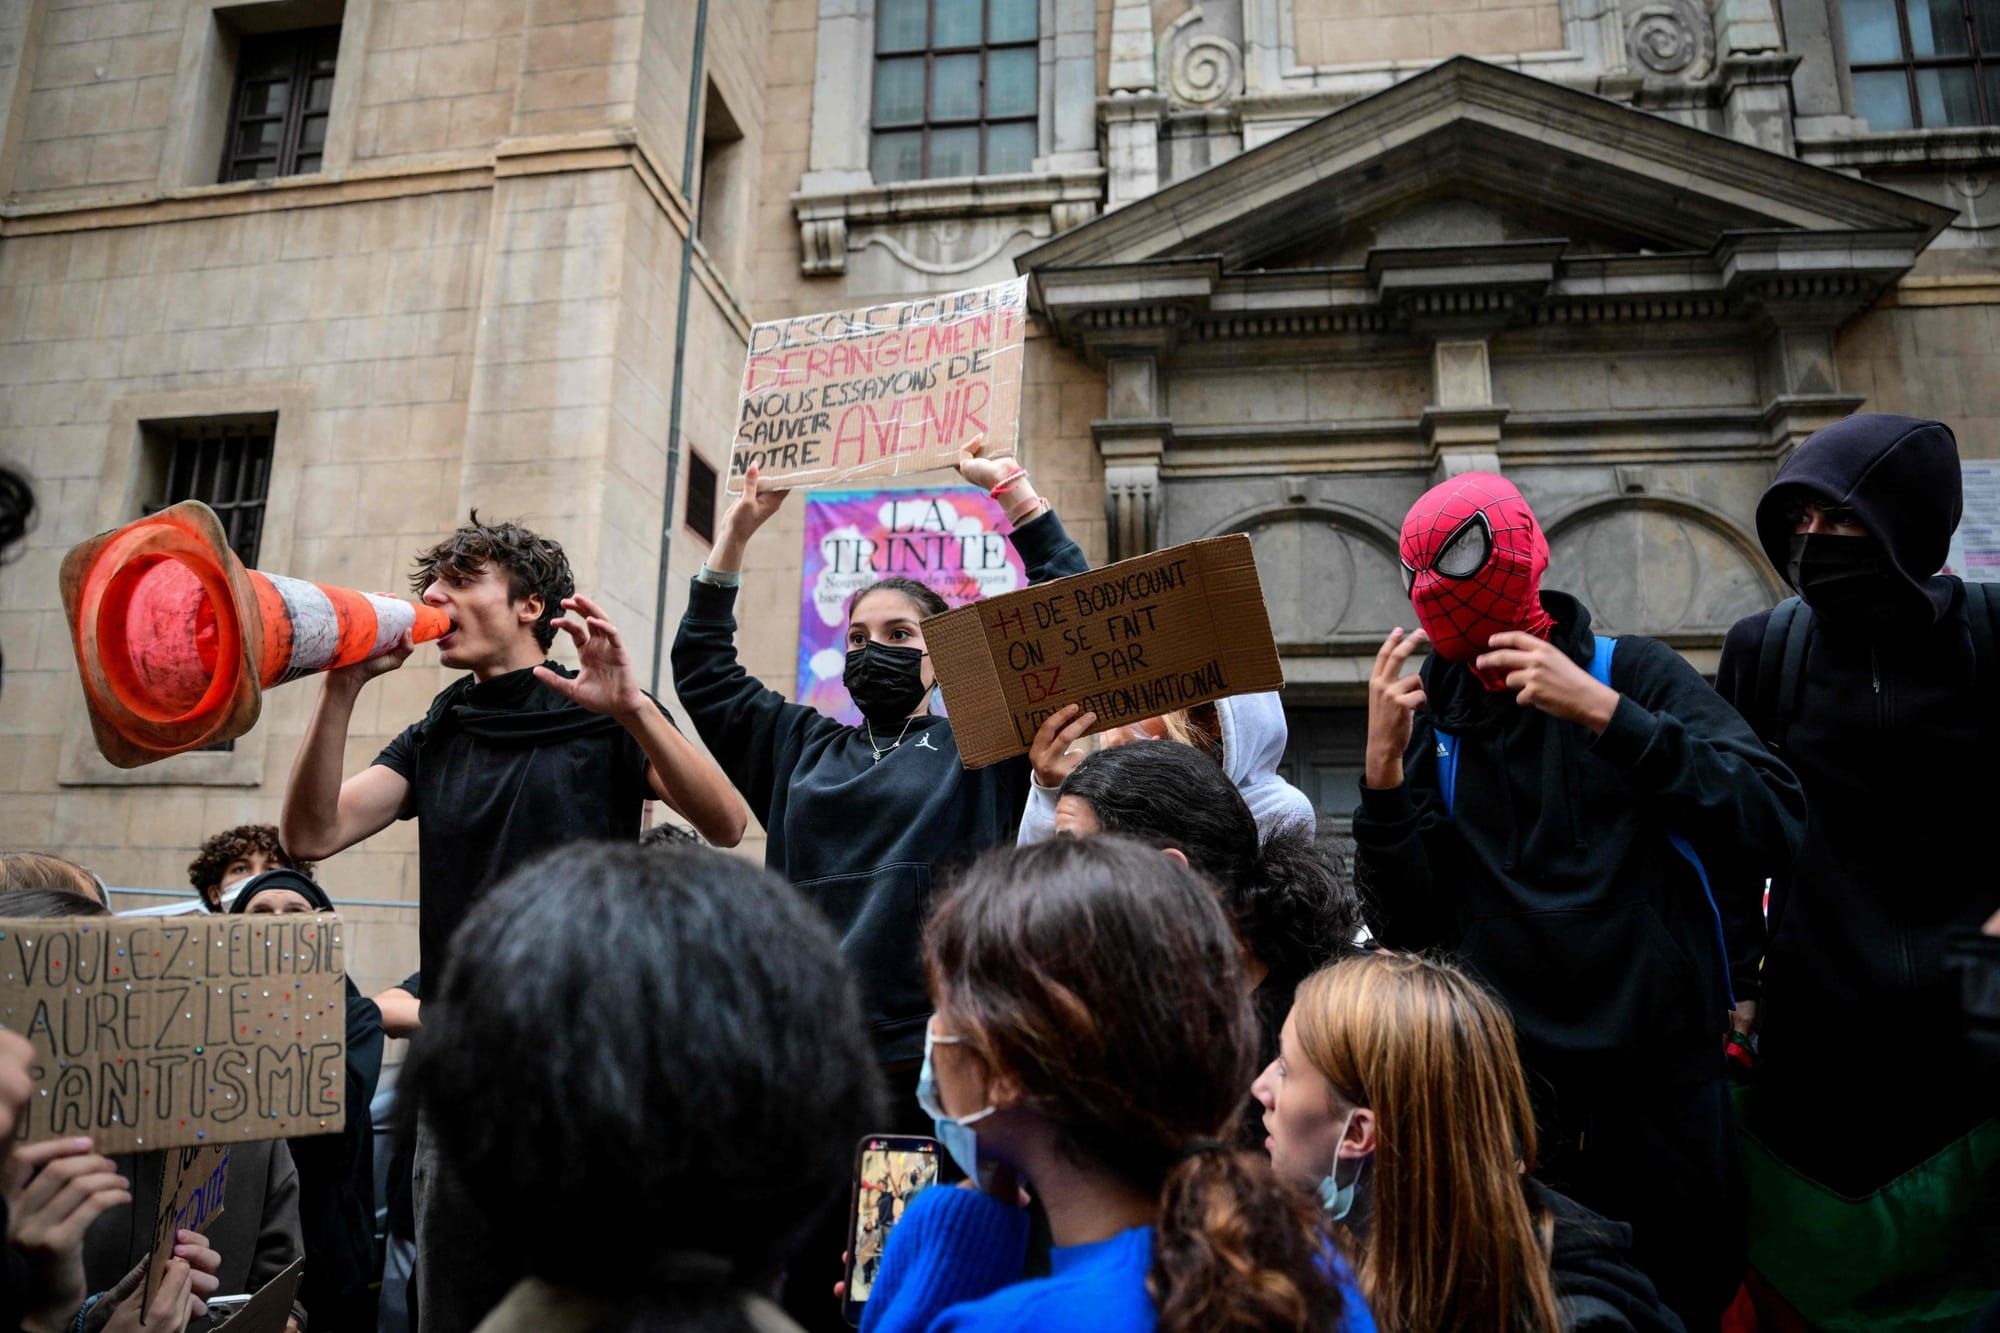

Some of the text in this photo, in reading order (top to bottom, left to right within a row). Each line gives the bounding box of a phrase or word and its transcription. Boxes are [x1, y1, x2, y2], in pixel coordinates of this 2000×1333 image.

[898, 291, 977, 331] POUR
[747, 308, 1015, 391] DERANGEMENT
[742, 348, 991, 422] NOUS ESSAYONS DE
[731, 378, 990, 476] NOTRE AVENIR
[738, 412, 831, 446] SAUVER
[825, 522, 1008, 574] TRINITÉ
[889, 499, 948, 534] LA
[1033, 595, 1068, 629] DE
[1074, 560, 1187, 617] BODYCOUNT
[1008, 605, 1158, 672] ON SE FAIT
[1021, 643, 1150, 704] BZ PAR
[15, 926, 191, 987] VOULEZ
[27, 982, 256, 1058] AUREZ LE
